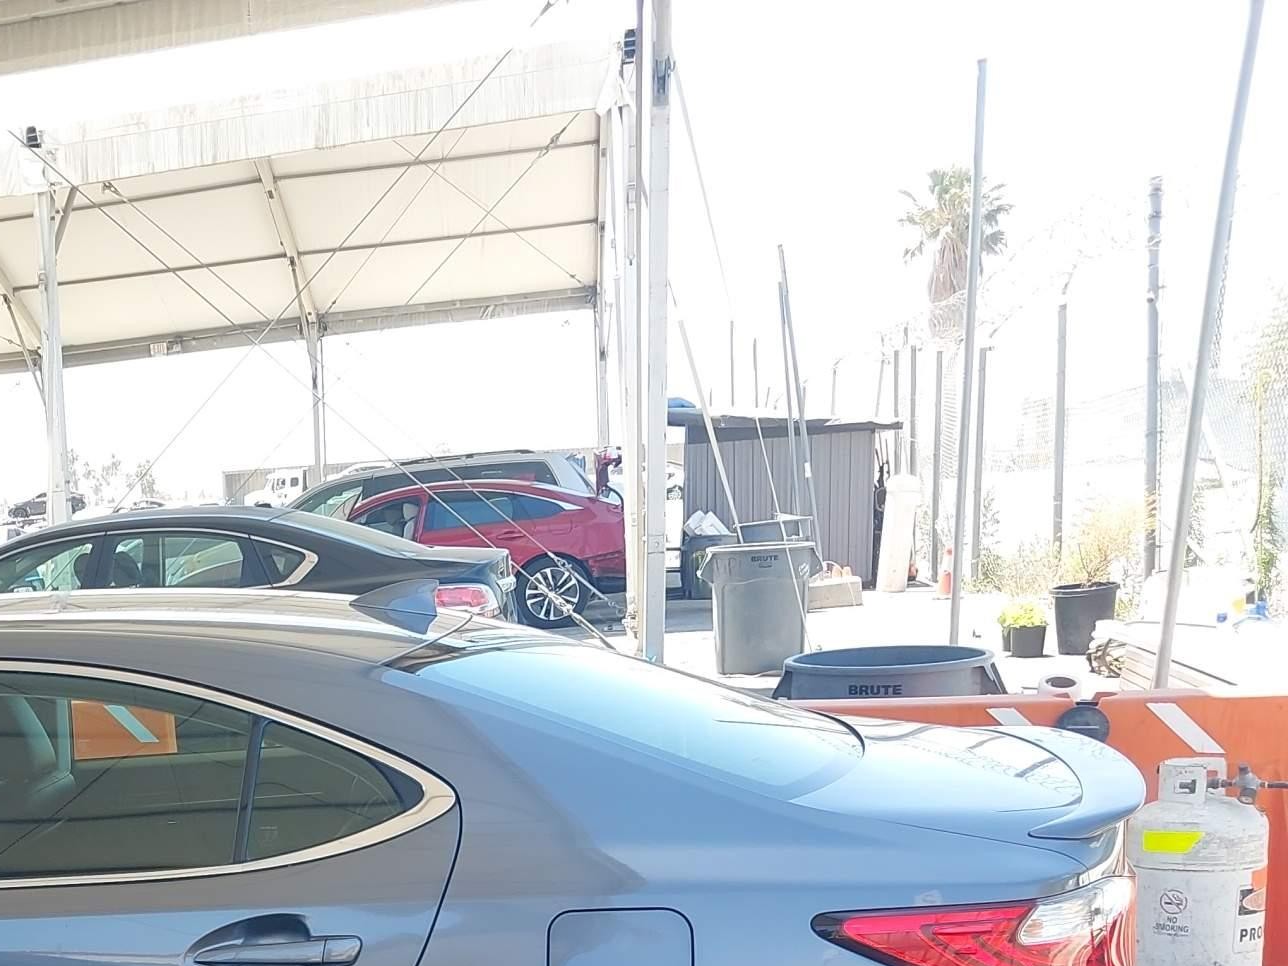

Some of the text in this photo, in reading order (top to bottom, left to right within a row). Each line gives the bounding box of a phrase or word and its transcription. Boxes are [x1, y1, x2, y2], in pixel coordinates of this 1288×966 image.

[848, 684, 903, 696] BRUTE
[1167, 916, 1178, 924] NO
[1154, 922, 1189, 934] SMOKING
